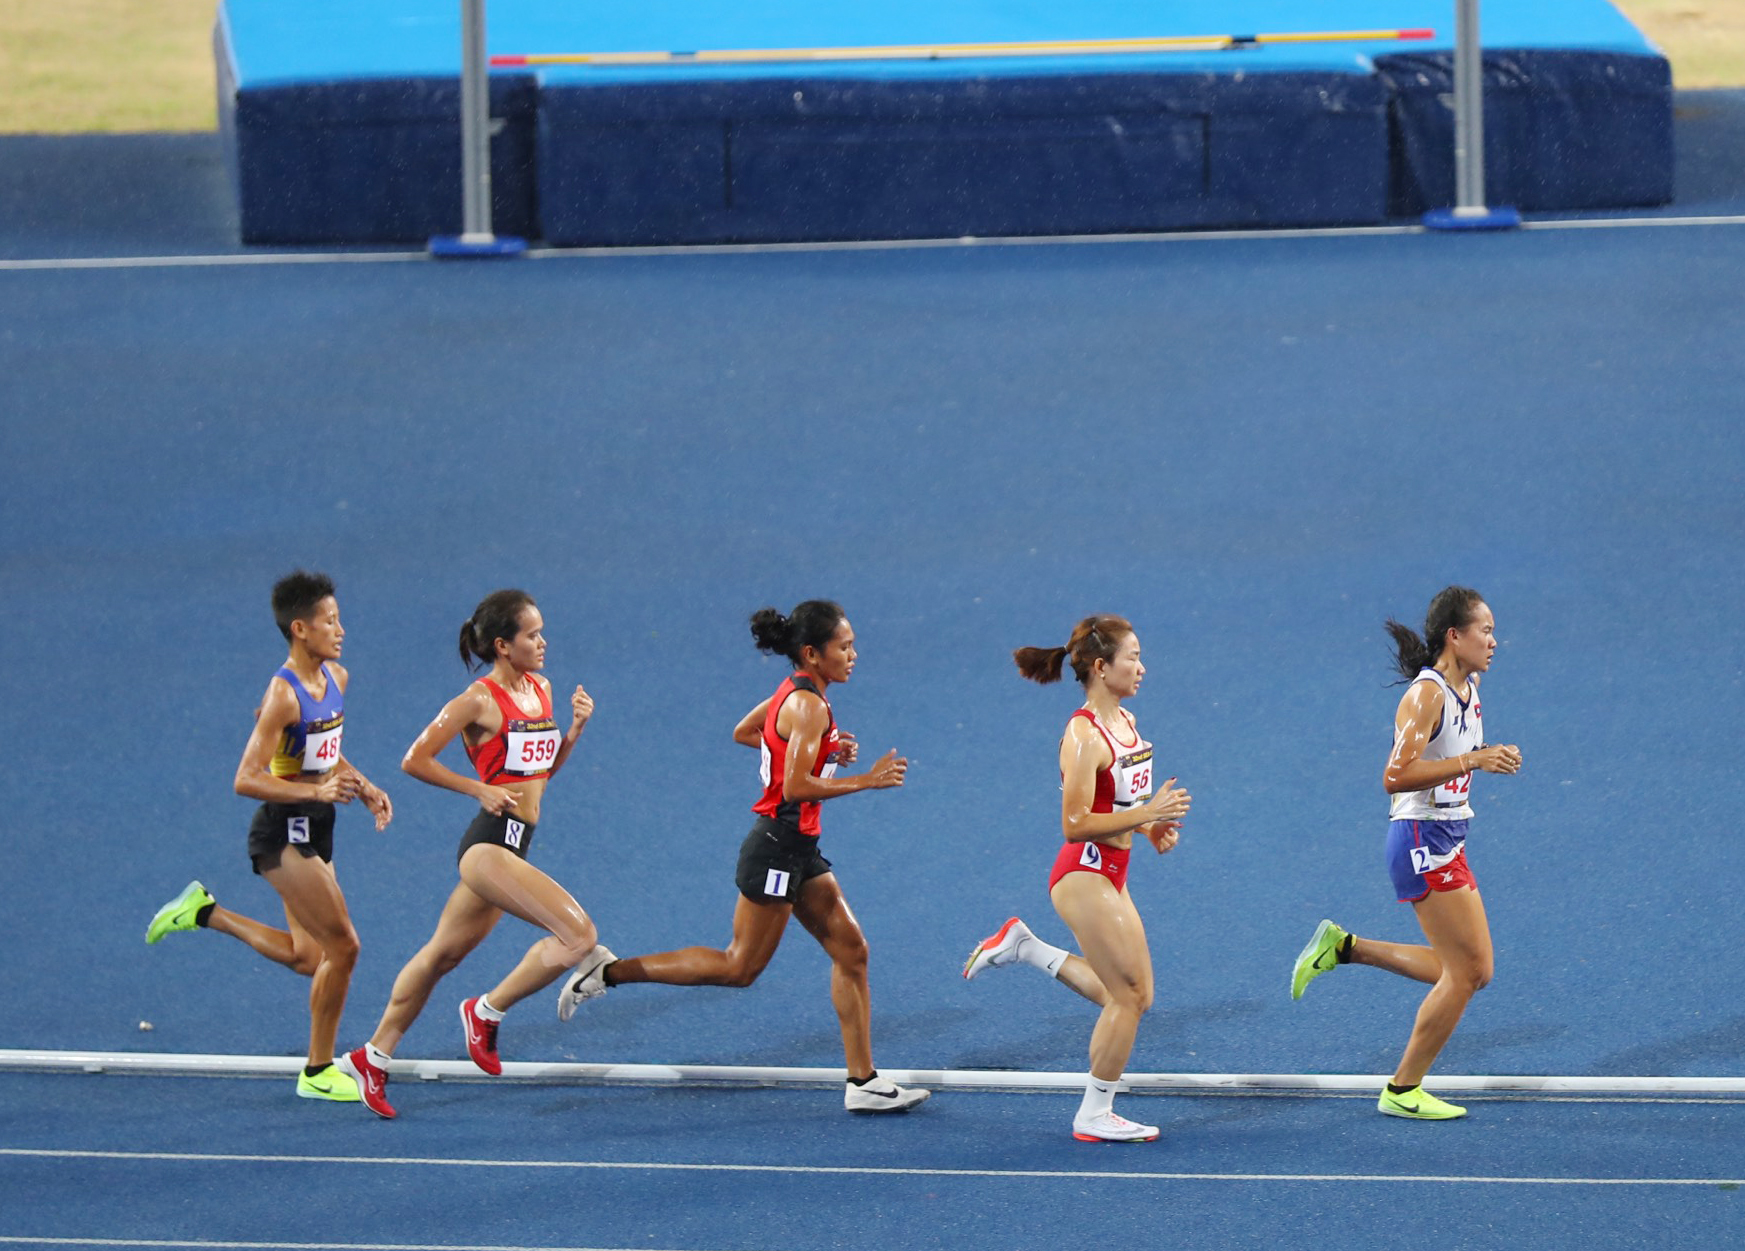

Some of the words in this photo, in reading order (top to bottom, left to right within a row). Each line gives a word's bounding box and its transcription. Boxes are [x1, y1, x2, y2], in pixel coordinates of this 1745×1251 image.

[521, 738, 555, 762] 559
[292, 819, 306, 842] 5
[508, 822, 520, 844] 8
[1085, 844, 1099, 864] 9
[1414, 849, 1430, 873] 2
[772, 872, 782, 895] 1
